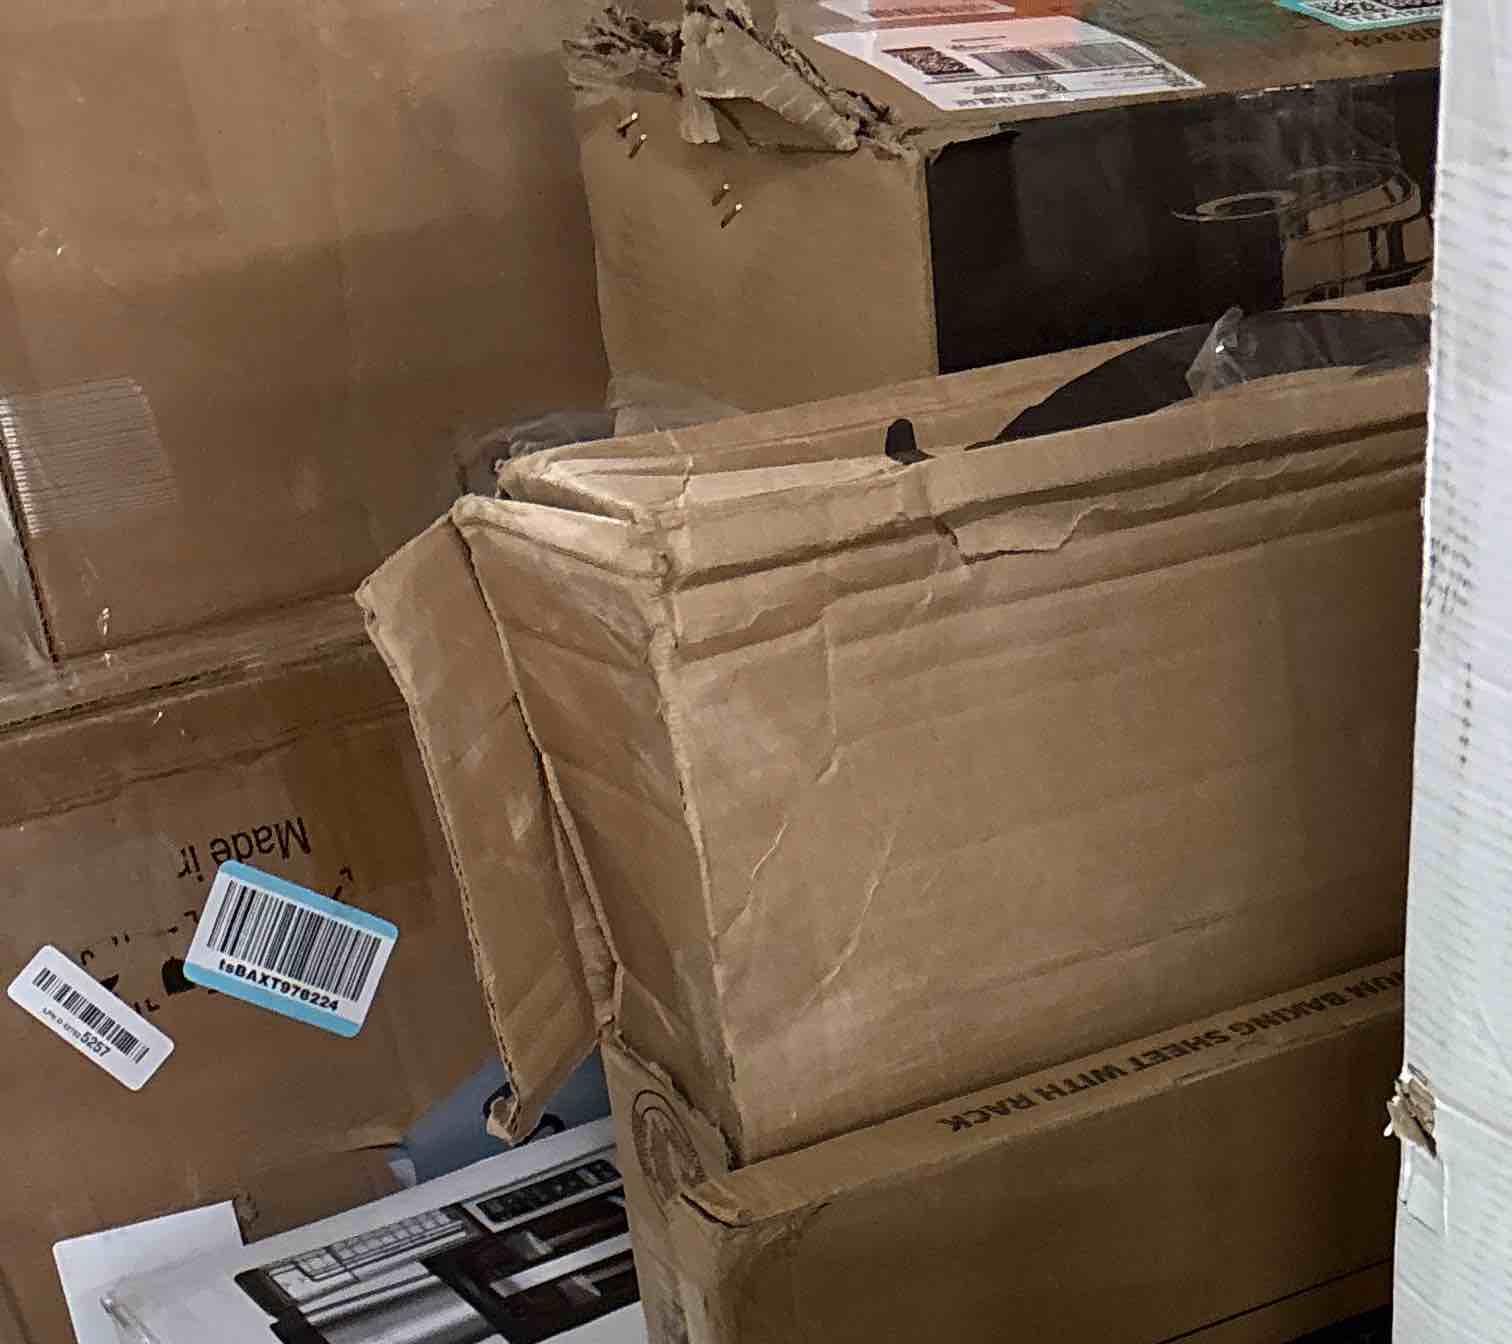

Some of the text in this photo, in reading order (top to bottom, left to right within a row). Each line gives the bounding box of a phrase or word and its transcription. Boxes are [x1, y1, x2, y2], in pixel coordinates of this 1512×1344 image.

[209, 816, 312, 866] Made
[80, 1031, 112, 1057] 5257
[1128, 1029, 1231, 1073] SHEET
[1035, 1064, 1128, 1102] WITH
[936, 1094, 1033, 1134] RACK
